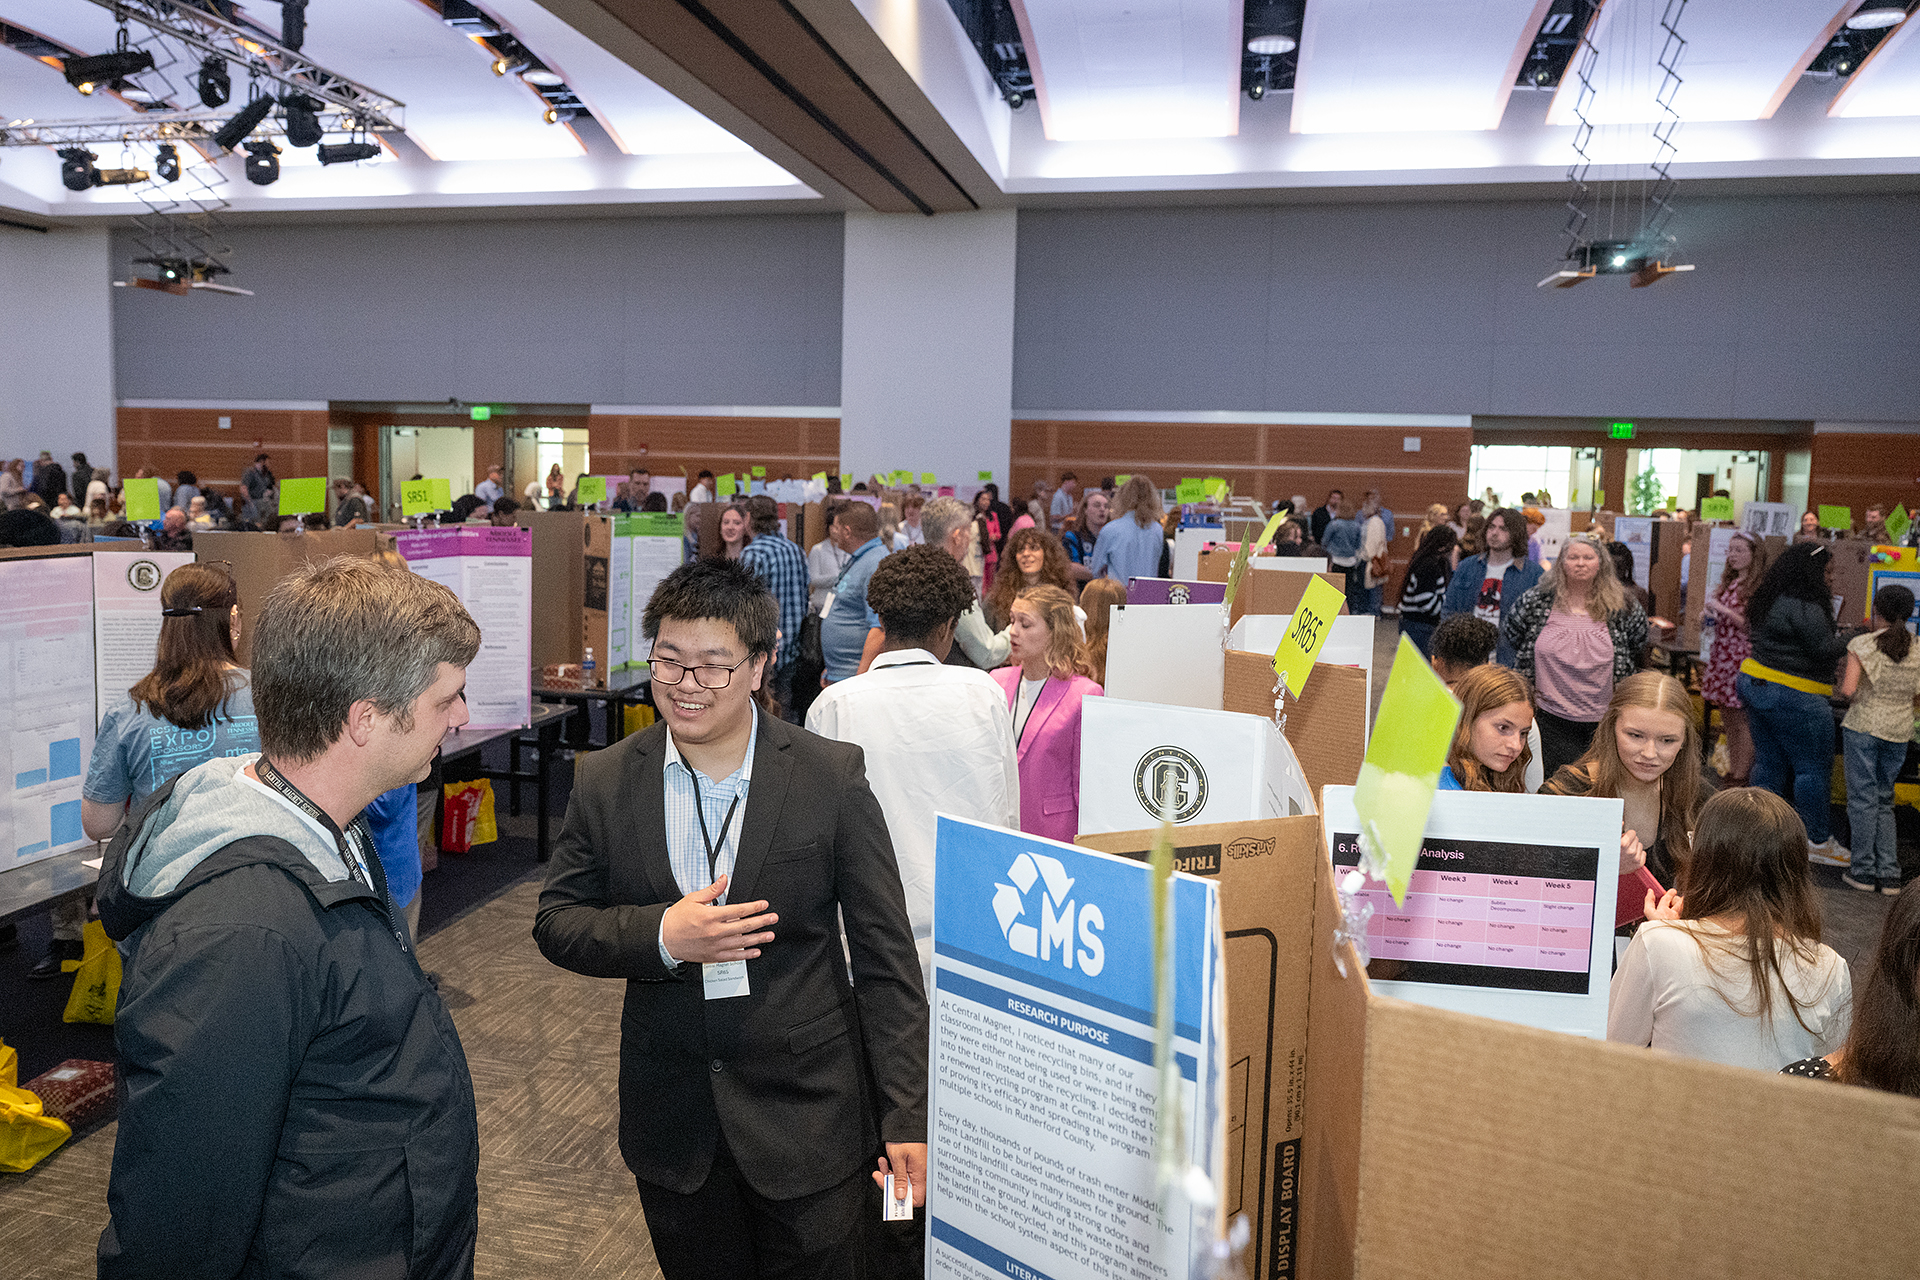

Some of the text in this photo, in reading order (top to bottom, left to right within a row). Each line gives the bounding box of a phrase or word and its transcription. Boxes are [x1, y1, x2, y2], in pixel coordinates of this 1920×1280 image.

[1612, 423, 1633, 438] EXIT
[407, 490, 428, 503] SR51
[1291, 607, 1323, 654] SR65
[149, 725, 171, 736] RCS
[150, 729, 210, 750] EXPO
[152, 743, 204, 756] SPONSORS
[1143, 750, 1198, 770] CENTRAL
[1172, 855, 1216, 872] TRIFO
[1338, 843, 1348, 853] 6.
[1420, 848, 1465, 860] Analysis
[1440, 874, 1460, 883] Week
[1492, 878, 1513, 886] Week
[1545, 881, 1566, 889] Week
[941, 1000, 1135, 1079] At Central Magnet, noticed that many our
[1007, 998, 1110, 1045] RESEARCH PURPOSE
[940, 1037, 956, 1051] into
[973, 1051, 993, 1067] trash
[995, 1060, 1025, 1080] instead
[1056, 1085, 1100, 1111] recycling.
[1109, 1106, 1146, 1128] decided
[941, 1013, 1158, 1105] classrooms have recycling bins, they
[941, 1026, 1137, 1112] they either being used were being
[940, 1052, 1128, 1136] a renewed recycling program Central with
[940, 1078, 1096, 1152] multiple schools Rutherford County.
[950, 1069, 978, 1089] proving
[981, 1080, 992, 1093] it's
[994, 1088, 1027, 1109] efficacy
[1048, 1110, 1090, 1137] spreading
[1111, 1137, 1150, 1160] program
[938, 1133, 1108, 1218] use this landfill causes many issues for
[938, 1119, 1174, 1235] Point Landfill buried underneath ground. The
[939, 1106, 960, 1126] Every
[962, 1118, 978, 1133] day,
[980, 1125, 1021, 1151] thousands
[1034, 1151, 1064, 1172] pounds
[1078, 1170, 1101, 1187] trash
[1104, 1183, 1130, 1200] enter
[1280, 1144, 1296, 1201] BOARD
[937, 1147, 1130, 1244] surrounding community including strong odors
[937, 1158, 971, 1181] leachate
[998, 1189, 1029, 1210] ground.
[1031, 1204, 1055, 1222] Much
[1085, 1230, 1113, 1250] waste
[1115, 1244, 1135, 1262] that
[1137, 1256, 1168, 1278] enters
[937, 1183, 954, 1199] help
[955, 1193, 973, 1208] with
[990, 1211, 1017, 1231] school
[1018, 1225, 1048, 1246] system
[1049, 1239, 1079, 1262] aspect
[1092, 1262, 1109, 1278] this
[951, 1178, 1128, 1273] landfill can recycled, this program
[1277, 1206, 1292, 1272] DISPLAY
[935, 1259, 953, 1273] order
[941, 1251, 974, 1275] successful
[1006, 1260, 1042, 1280] LITERA
